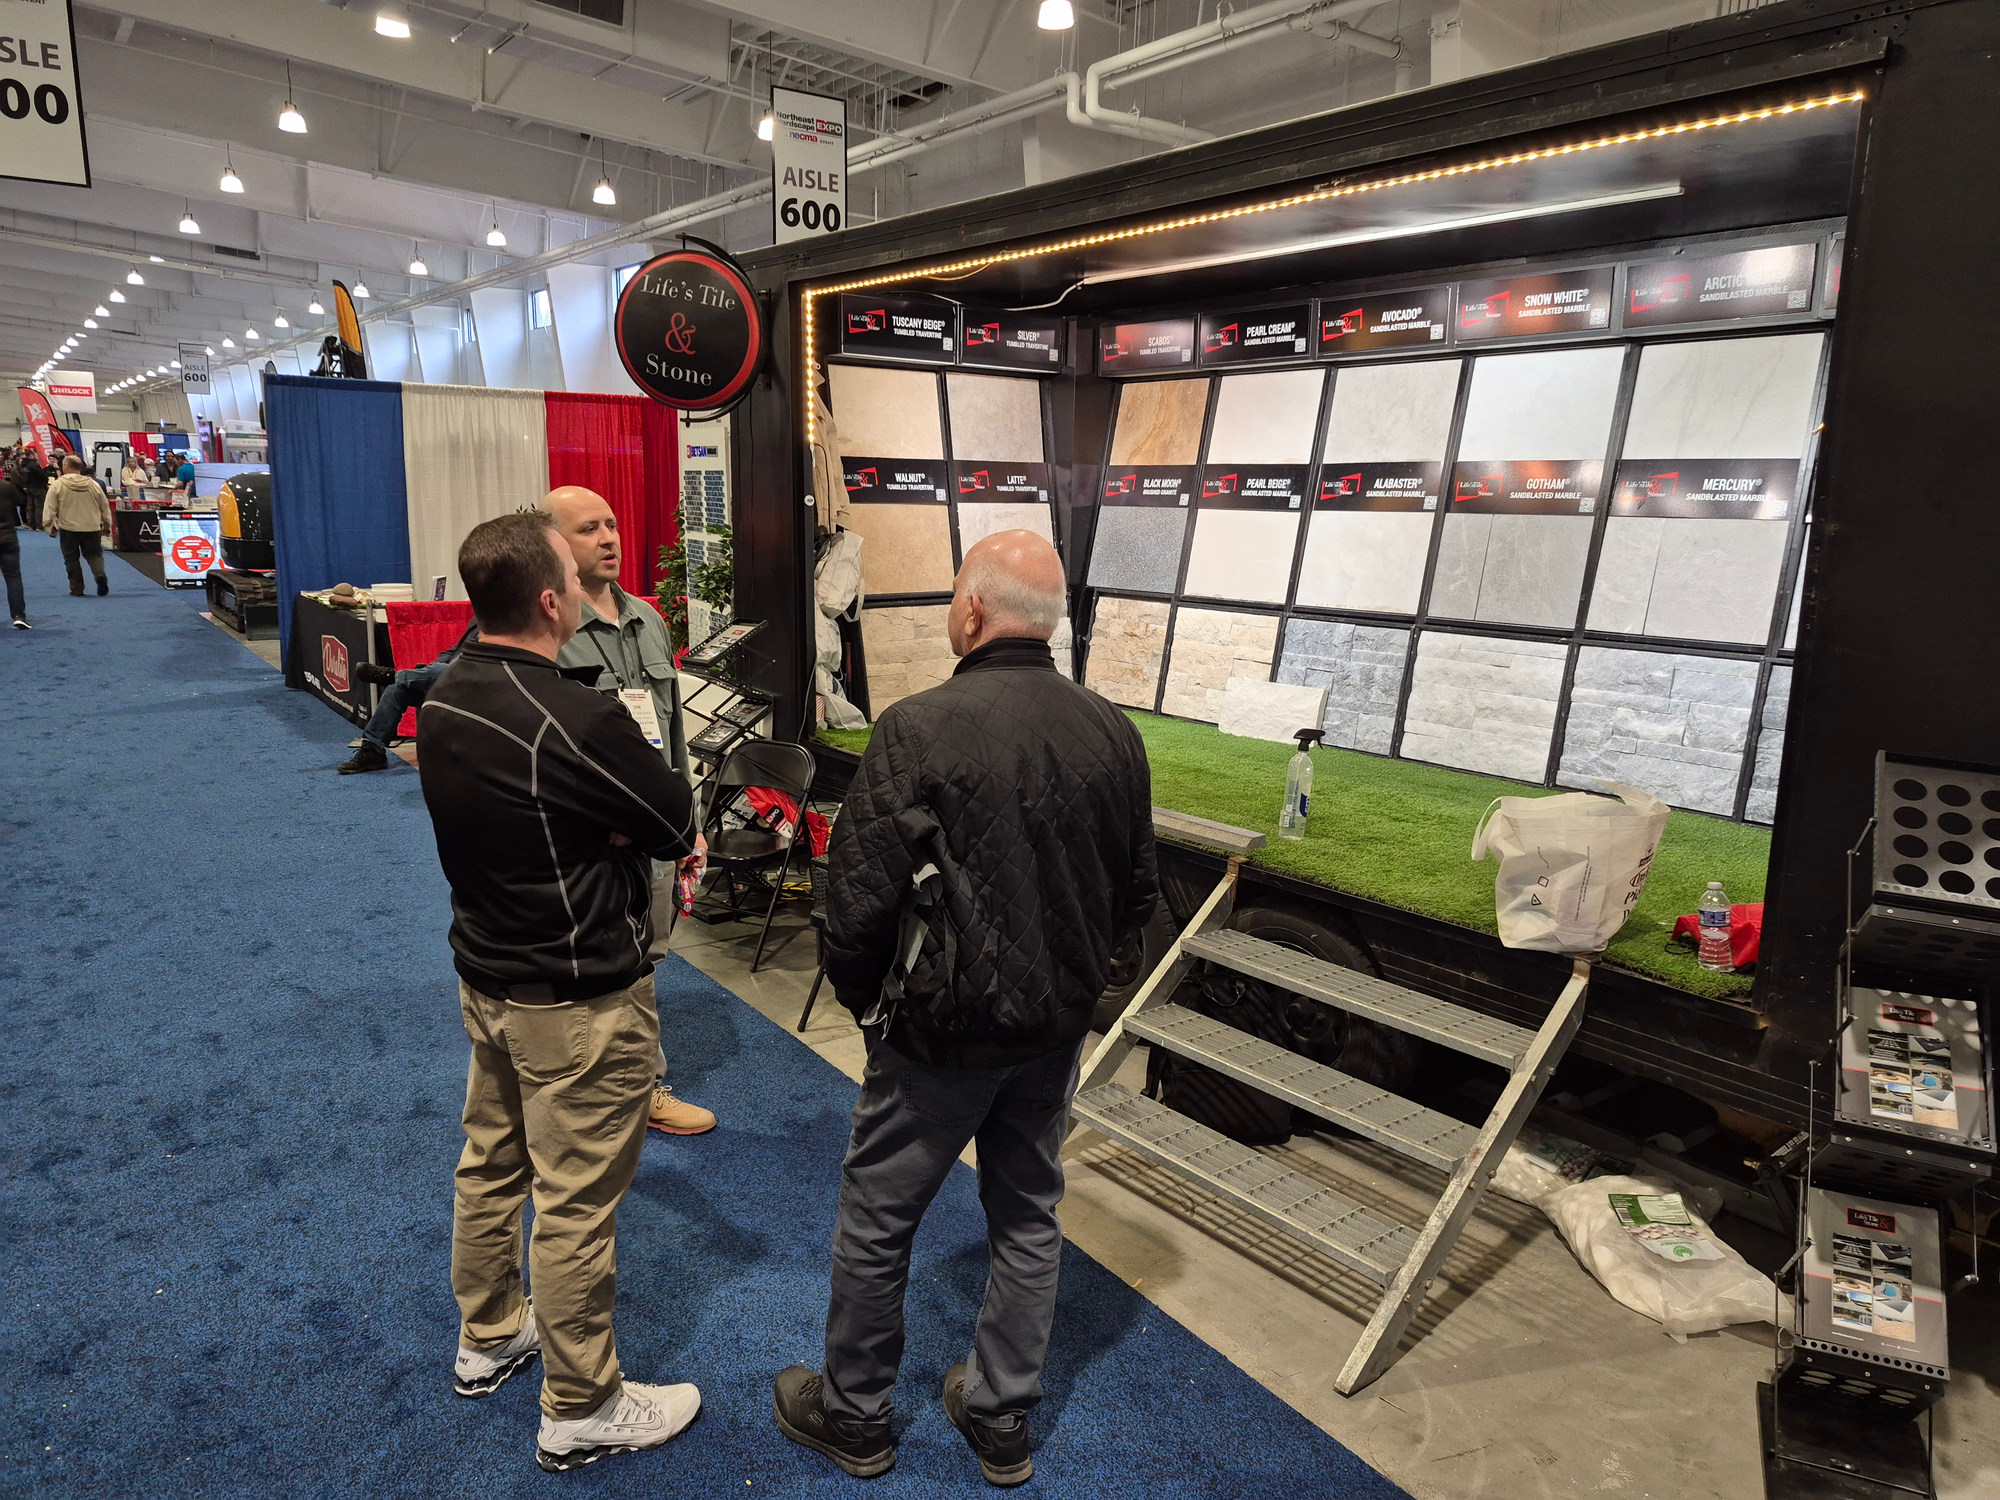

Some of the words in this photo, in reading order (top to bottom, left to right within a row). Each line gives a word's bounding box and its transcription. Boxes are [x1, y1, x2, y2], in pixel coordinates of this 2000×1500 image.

[776, 111, 815, 124] Northeast
[776, 118, 815, 131] ardscape
[816, 122, 842, 134] EXPO
[790, 131, 818, 142] necma
[782, 166, 839, 193] AISLE
[780, 198, 841, 232] 600
[1704, 274, 1742, 290] ARCTIC
[640, 274, 694, 301] Life's
[700, 284, 736, 310] Tile
[1700, 290, 1754, 302] SANDBLASTED
[1756, 286, 1788, 296] MARBLE
[1524, 292, 1552, 308] SNOW
[1518, 308, 1563, 318] SANDBLASTED
[1564, 304, 1591, 314] MARBLE
[892, 316, 922, 328] TUSCANY
[1370, 322, 1408, 334] SANDBLASTED
[1408, 320, 1432, 330] MARBLE
[665, 312, 696, 355] &
[894, 328, 915, 336] TUMBLED
[916, 330, 942, 340] TRAVERTINE
[1246, 326, 1268, 338] PEARL
[1006, 340, 1025, 348] TUMBLED
[184, 364, 206, 372] AISLE
[646, 353, 712, 386] Stone
[184, 372, 207, 382] 600
[1142, 478, 1161, 488] BLACK
[1246, 478, 1266, 488] PEARL
[1686, 492, 1739, 501] SANDBLASTED
